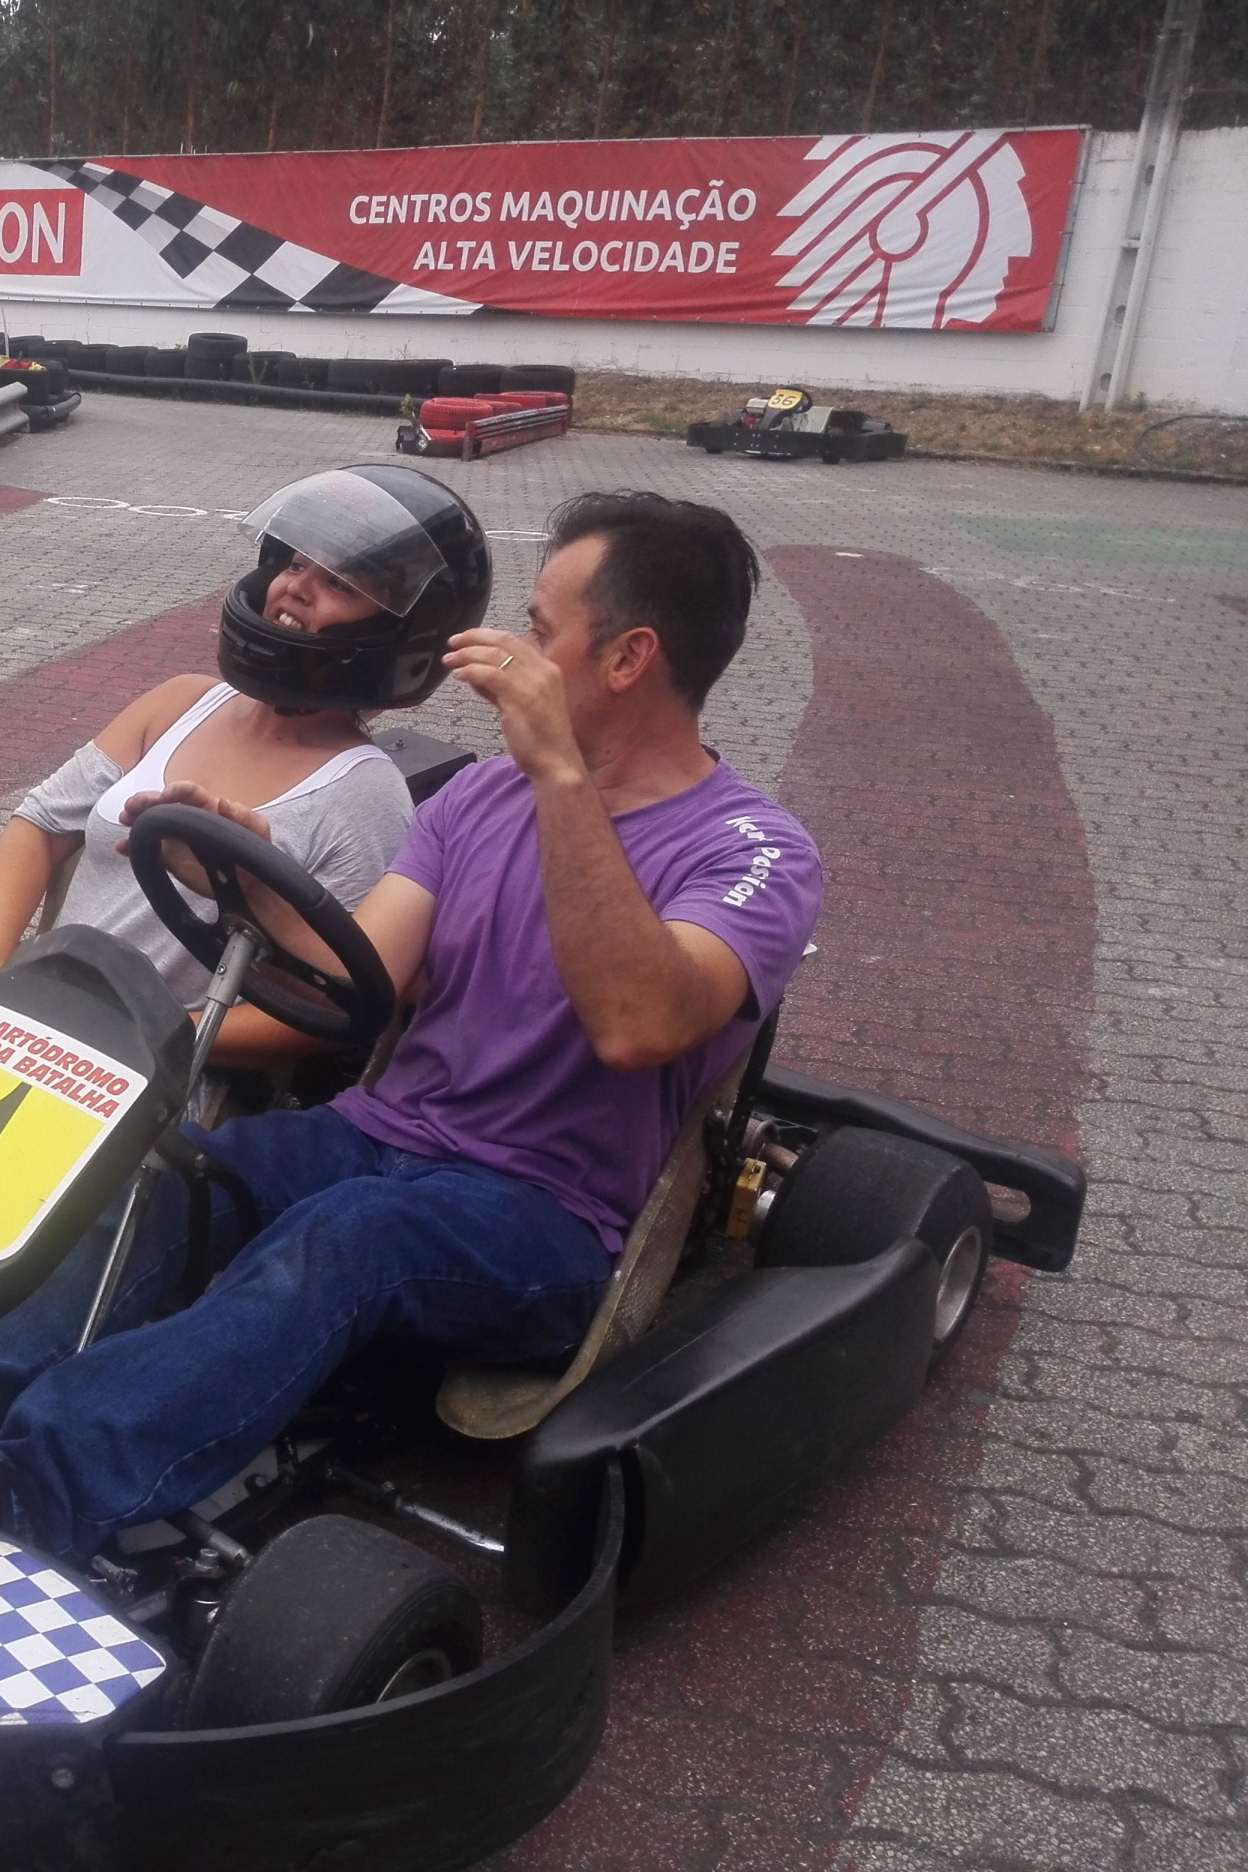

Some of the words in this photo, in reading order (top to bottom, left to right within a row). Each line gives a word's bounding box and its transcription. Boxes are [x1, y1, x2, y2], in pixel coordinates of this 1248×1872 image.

[349, 191, 492, 225] CENTROS
[499, 179, 757, 231] MAQUINAÇÃO
[413, 240, 497, 271] ALTA
[506, 240, 741, 275] VELOCIDADE
[12, 1055, 120, 1119] BATALHA
